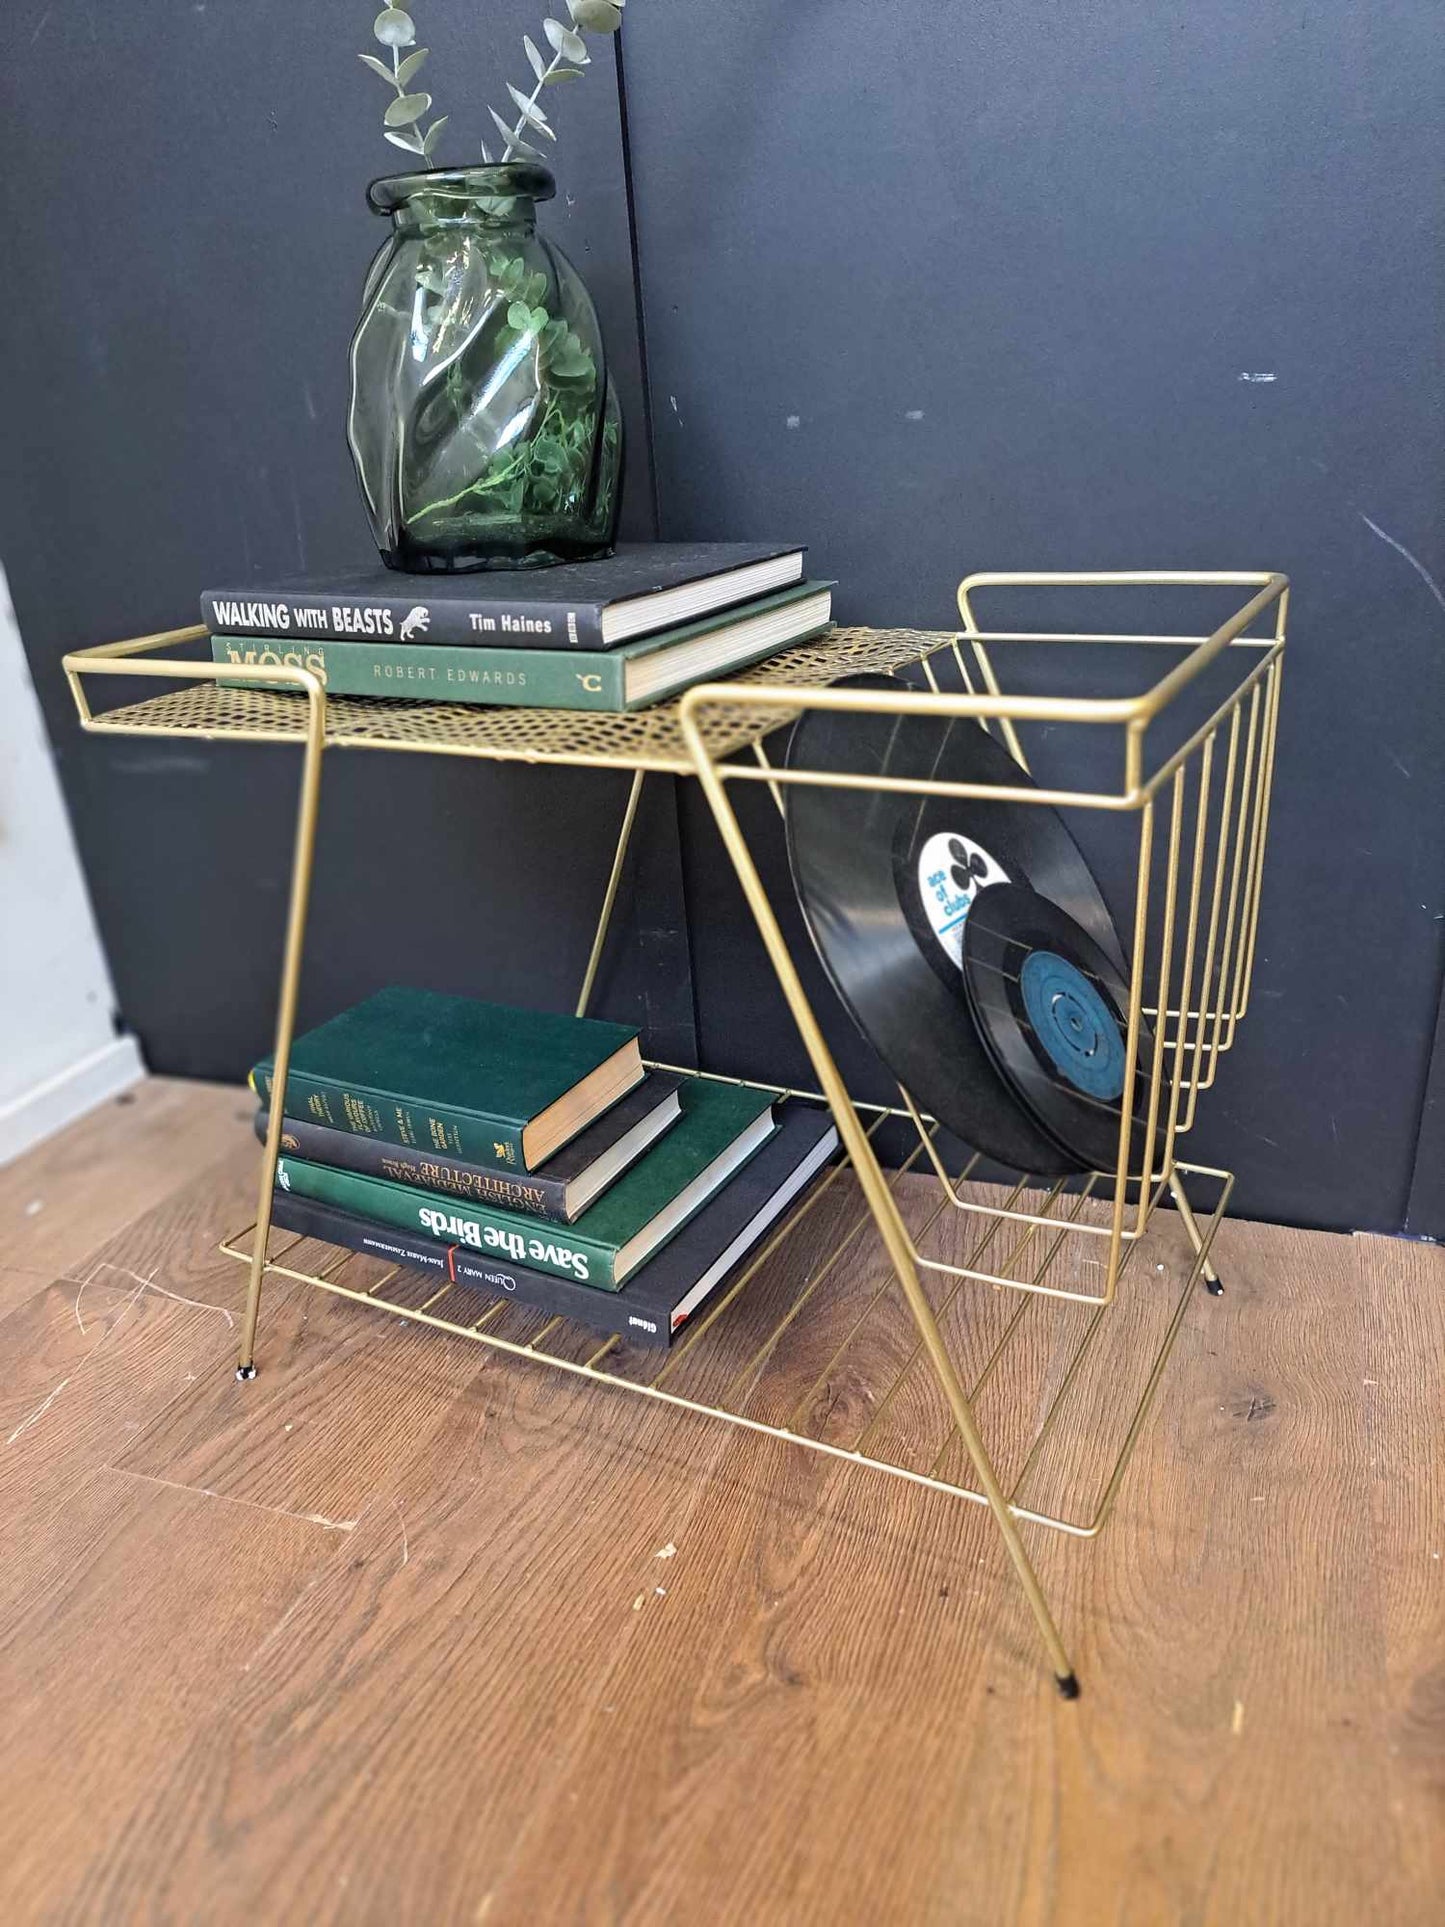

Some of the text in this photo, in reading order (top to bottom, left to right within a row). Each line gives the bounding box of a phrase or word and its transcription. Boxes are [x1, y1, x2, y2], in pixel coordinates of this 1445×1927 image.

[212, 601, 394, 635] WALKING WITH BEASTS
[469, 613, 496, 631] Tim
[501, 614, 552, 634] Haines
[225, 642, 325, 657] STIRLING
[373, 664, 527, 686] ROBERT EDWARDS
[927, 871, 946, 887] ace
[936, 884, 948, 902] of
[944, 893, 971, 916] clubs
[420, 1162, 545, 1202] ARCHITECTURE
[418, 1207, 590, 1280] Save the Birds
[457, 1264, 516, 1291] QUEEN MARY 2
